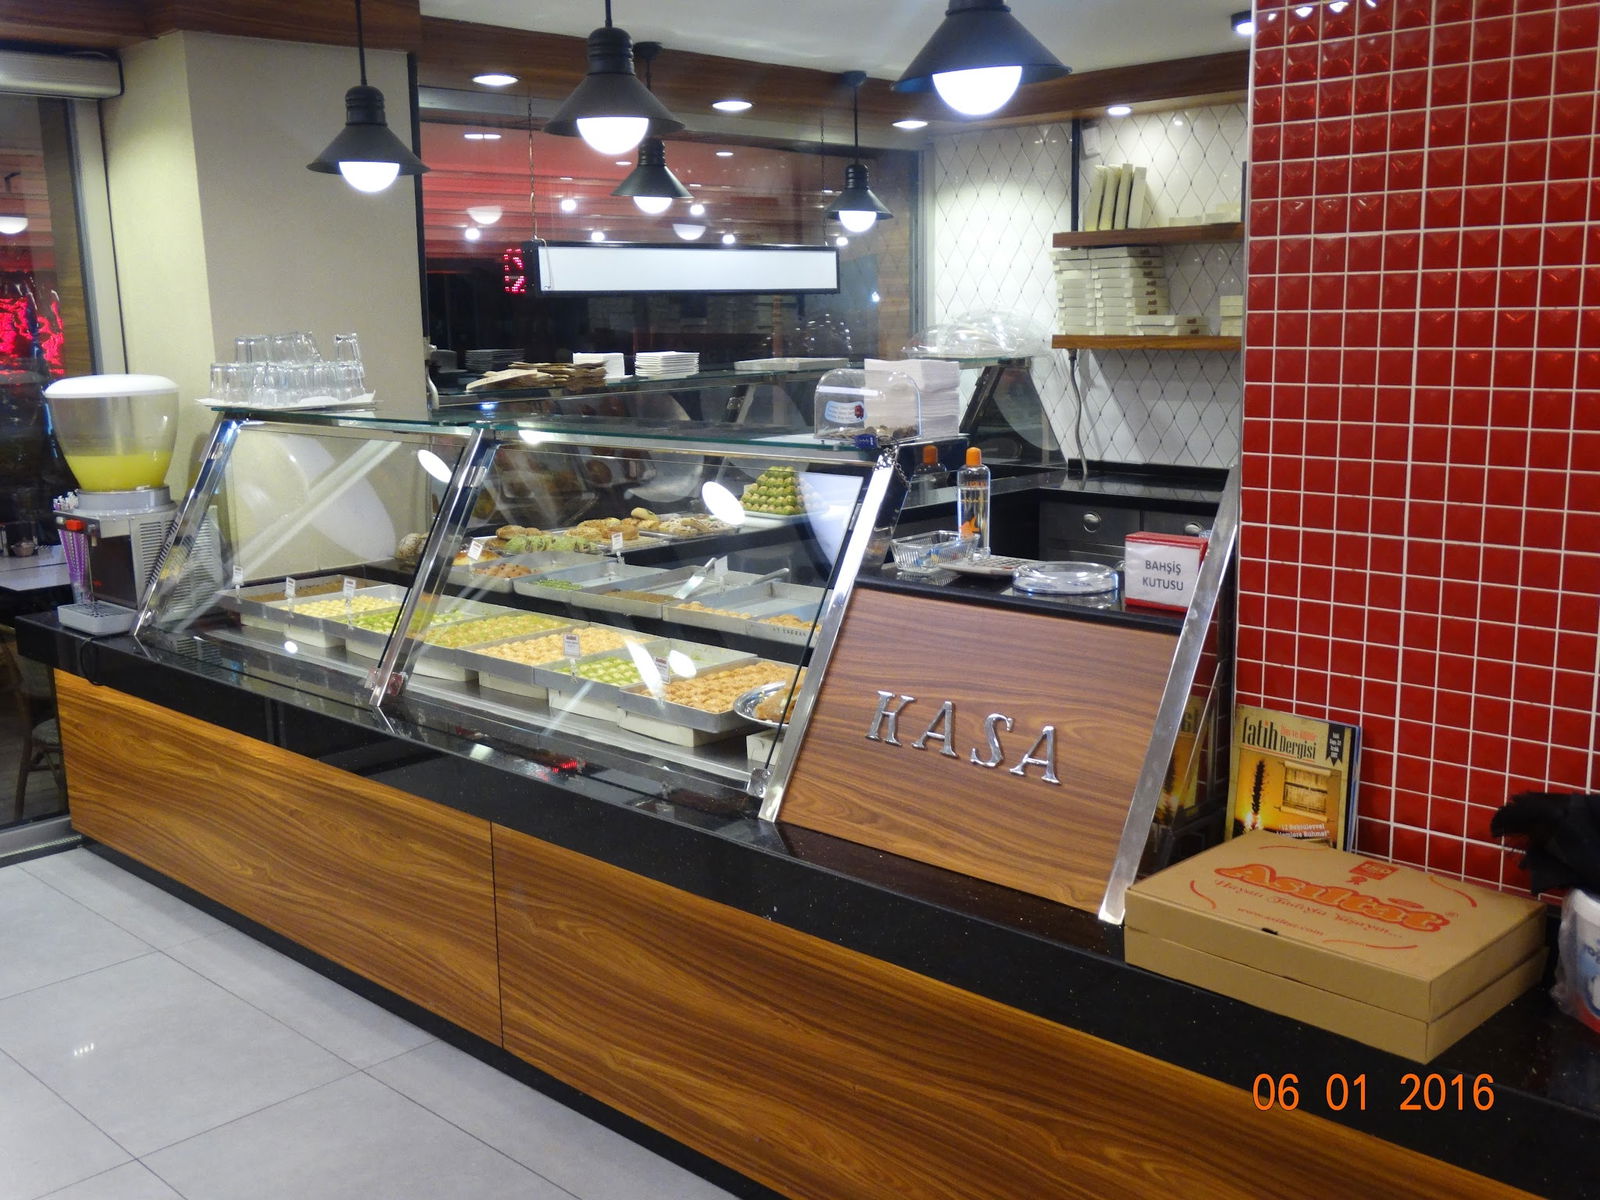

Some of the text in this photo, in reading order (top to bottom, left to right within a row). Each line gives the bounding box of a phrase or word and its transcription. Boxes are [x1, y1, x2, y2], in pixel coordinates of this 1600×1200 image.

[1145, 559, 1182, 576] BAHŞİŞ
[1142, 577, 1184, 591] KUTUSU
[865, 690, 1063, 786] KASA
[1279, 735, 1317, 761] Dergisi
